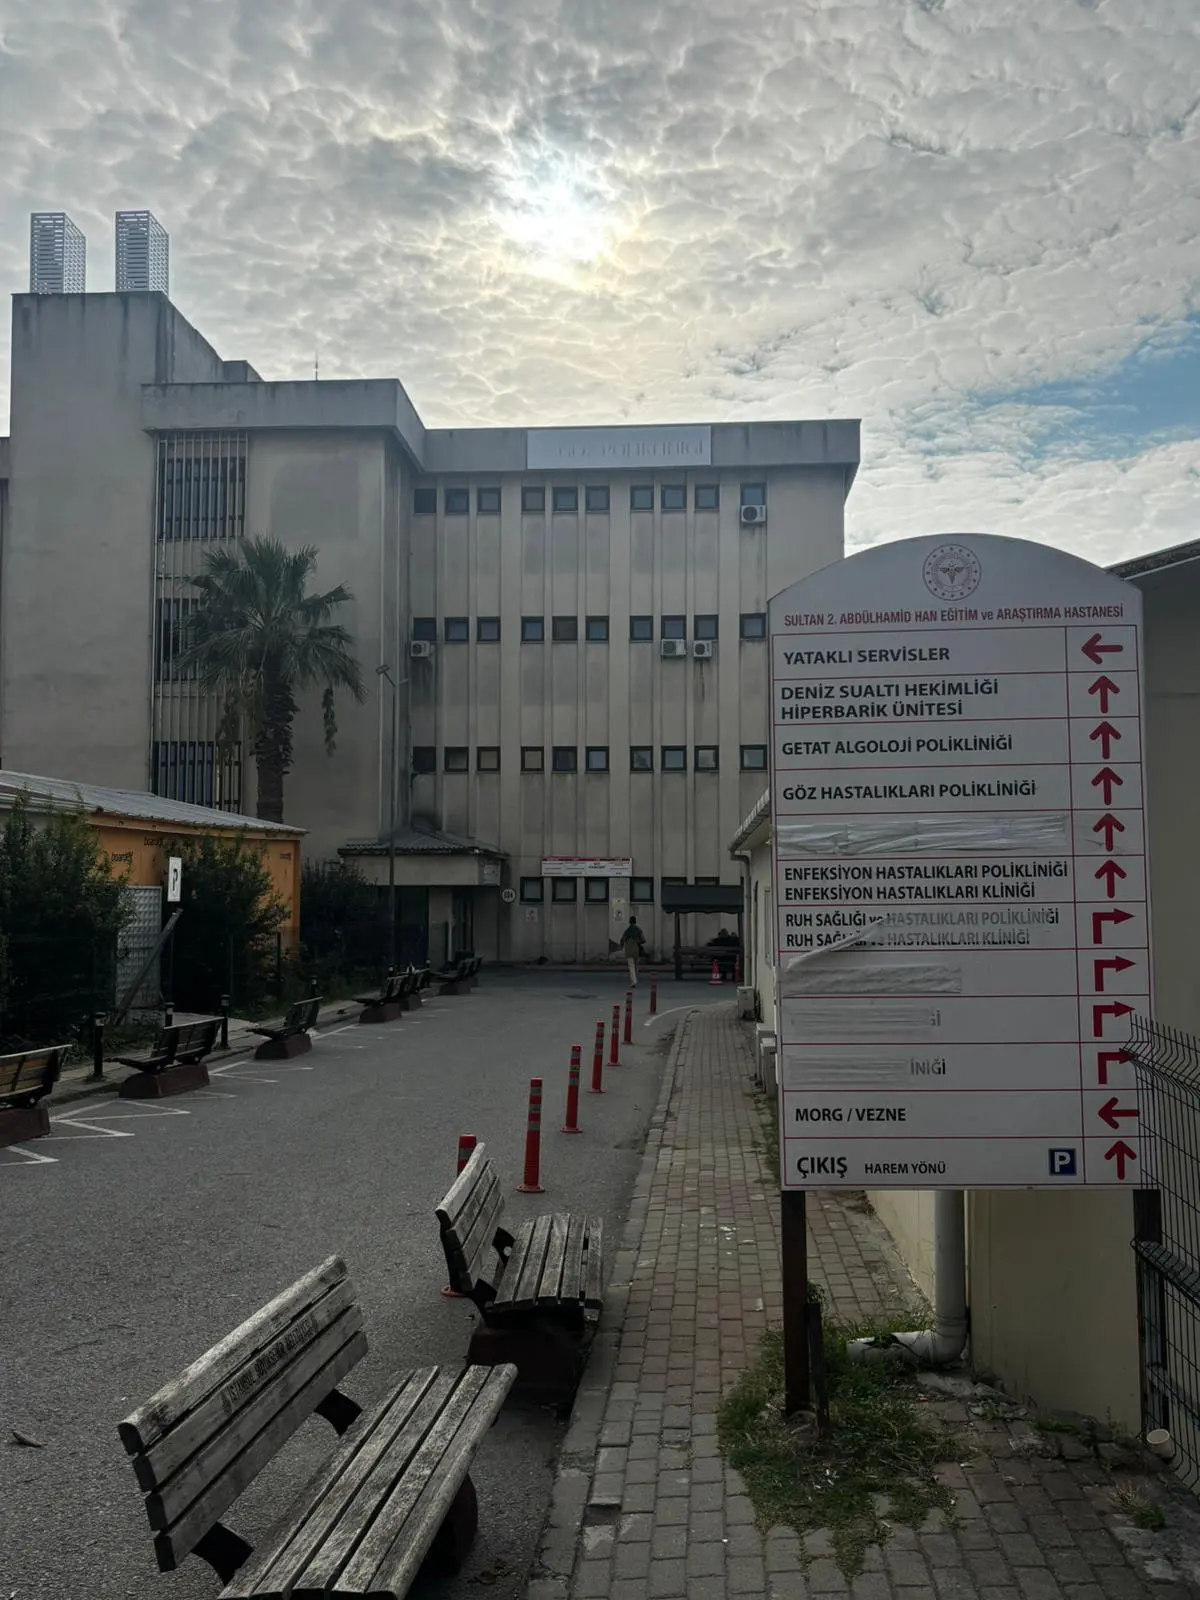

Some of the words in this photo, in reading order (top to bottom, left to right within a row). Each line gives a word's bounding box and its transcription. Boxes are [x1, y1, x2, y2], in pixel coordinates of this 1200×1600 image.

[784, 613, 825, 627] SULTAN
[827, 613, 838, 626] 2.
[840, 608, 912, 625] ABDÜLHAMİD
[915, 609, 938, 624] HAN
[941, 605, 978, 623] EĞİTİM
[981, 611, 994, 621] ve
[996, 606, 1061, 624] ARAŞTIRMA
[1064, 602, 1124, 619] HASTANESİ
[784, 649, 853, 666] YATAKLI
[857, 645, 950, 664] SERVİSLER
[781, 682, 836, 701] DENİZ
[839, 683, 900, 700] SUALTI
[904, 678, 999, 698] HEKİMLİĞİ
[781, 700, 888, 720] HİPERBARİK
[892, 699, 963, 718] ÜNİTESİ
[782, 740, 832, 756] GETAT
[834, 736, 912, 755] ALGOLOJİ
[916, 733, 1013, 753] POLİKLİNİĞİ
[782, 784, 818, 801] GÖZ
[820, 784, 935, 800] HASTALIKLARI
[938, 779, 1036, 798] POLİKLİNİĞİ
[784, 862, 874, 881] ENFEKSİYON
[876, 864, 978, 880] HASTALIKLARI
[981, 859, 1069, 878] POLİKLİNİĞİ
[784, 882, 874, 901] ENFEKSİYON
[876, 884, 979, 900] HASTALIKLARI
[982, 880, 1036, 898] KLİNİĞİ
[785, 912, 813, 927] RUH
[815, 909, 867, 927] SAĞLIĞI
[887, 911, 979, 927] HASTALIKLARI
[981, 907, 1060, 926] POLİKLİNİĞİ
[786, 933, 814, 947] RUH
[887, 931, 979, 947] HASTALIKLARI
[981, 928, 1031, 946] KLİNİĞİ
[795, 1107, 844, 1122] MORG
[855, 1107, 907, 1122] VEZNE
[796, 1156, 848, 1179] ÇIKIŞ
[864, 1162, 909, 1175] HAREM
[911, 1160, 947, 1175] YÖNÜ
[1054, 1151, 1071, 1173] P
